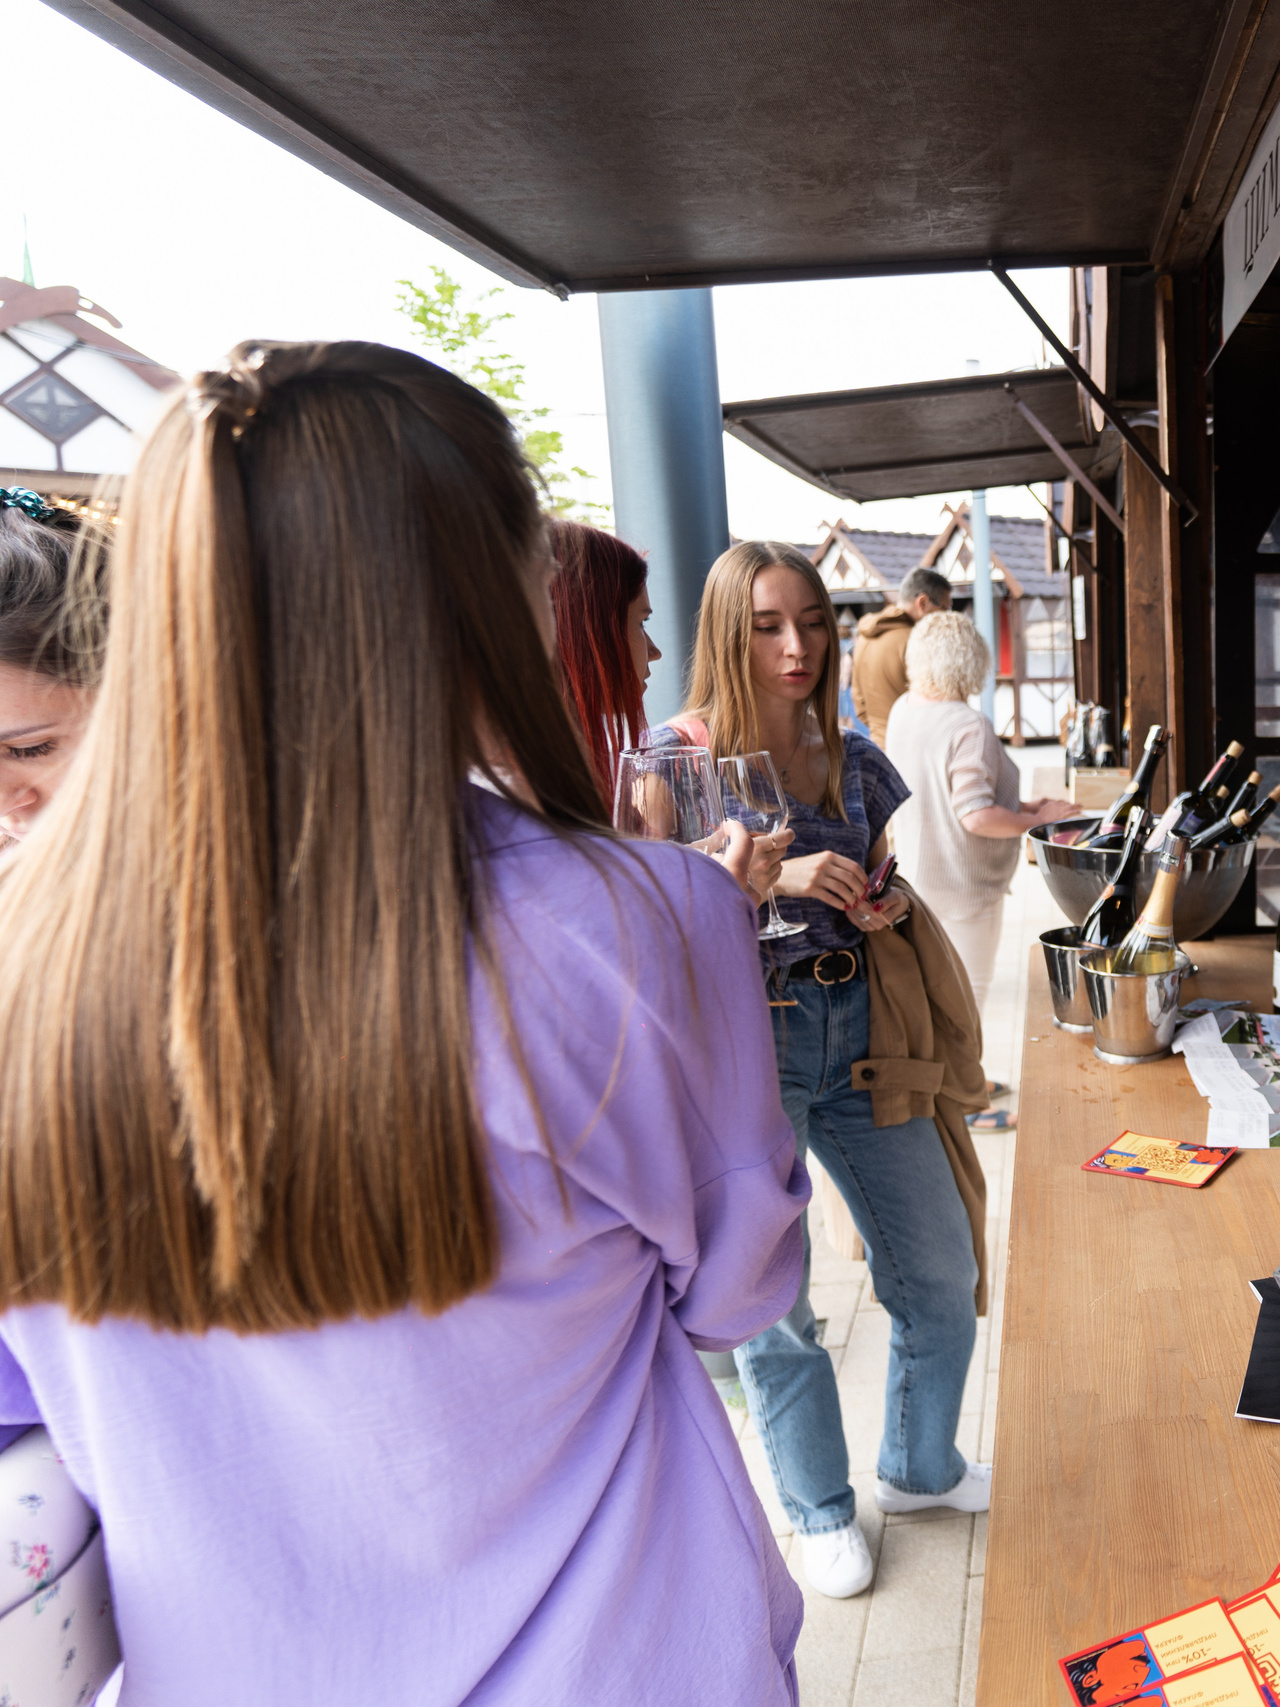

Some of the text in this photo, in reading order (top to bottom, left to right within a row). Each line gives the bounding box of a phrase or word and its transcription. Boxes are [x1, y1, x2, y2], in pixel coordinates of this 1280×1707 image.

[1154, 1634, 1184, 1651] ФЛАЕРА
[1160, 1631, 1218, 1660] ПРЕДЪЯВЛЕНИИ
[1165, 1646, 1212, 1669] -10% ПРИ
